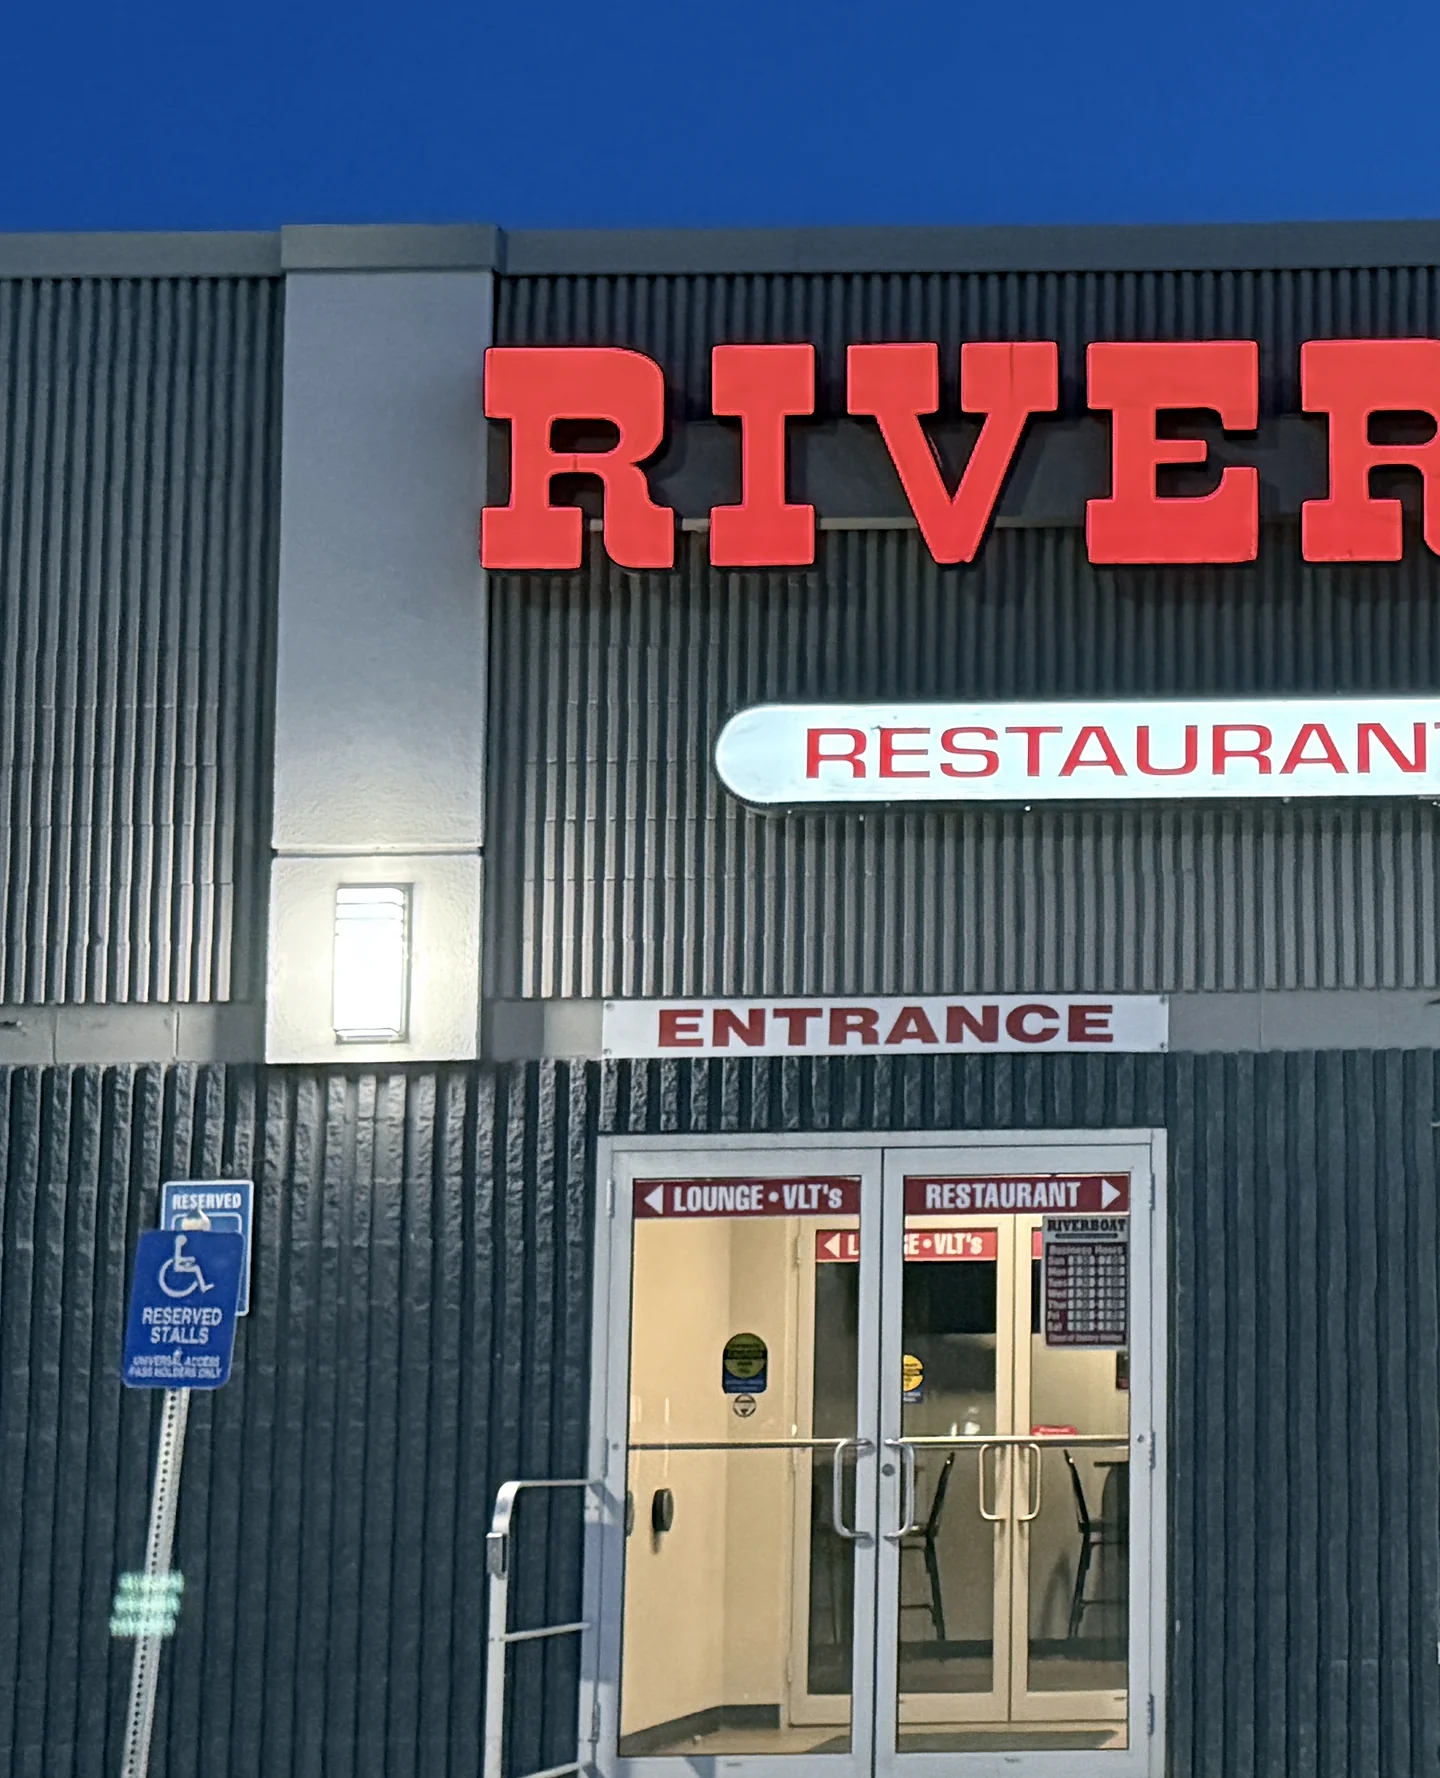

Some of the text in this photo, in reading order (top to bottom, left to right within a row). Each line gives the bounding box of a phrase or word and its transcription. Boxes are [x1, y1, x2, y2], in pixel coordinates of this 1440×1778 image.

[657, 1004, 1114, 1048] ENTRANCE
[171, 1193, 242, 1210] RESERVED
[673, 1183, 842, 1212] LOUNGE VLT's
[925, 1182, 1081, 1208] RESTAURANT
[1046, 1218, 1127, 1231] RIVERBOAT
[141, 1306, 223, 1326] RESERVED
[150, 1326, 210, 1344] STALLS
